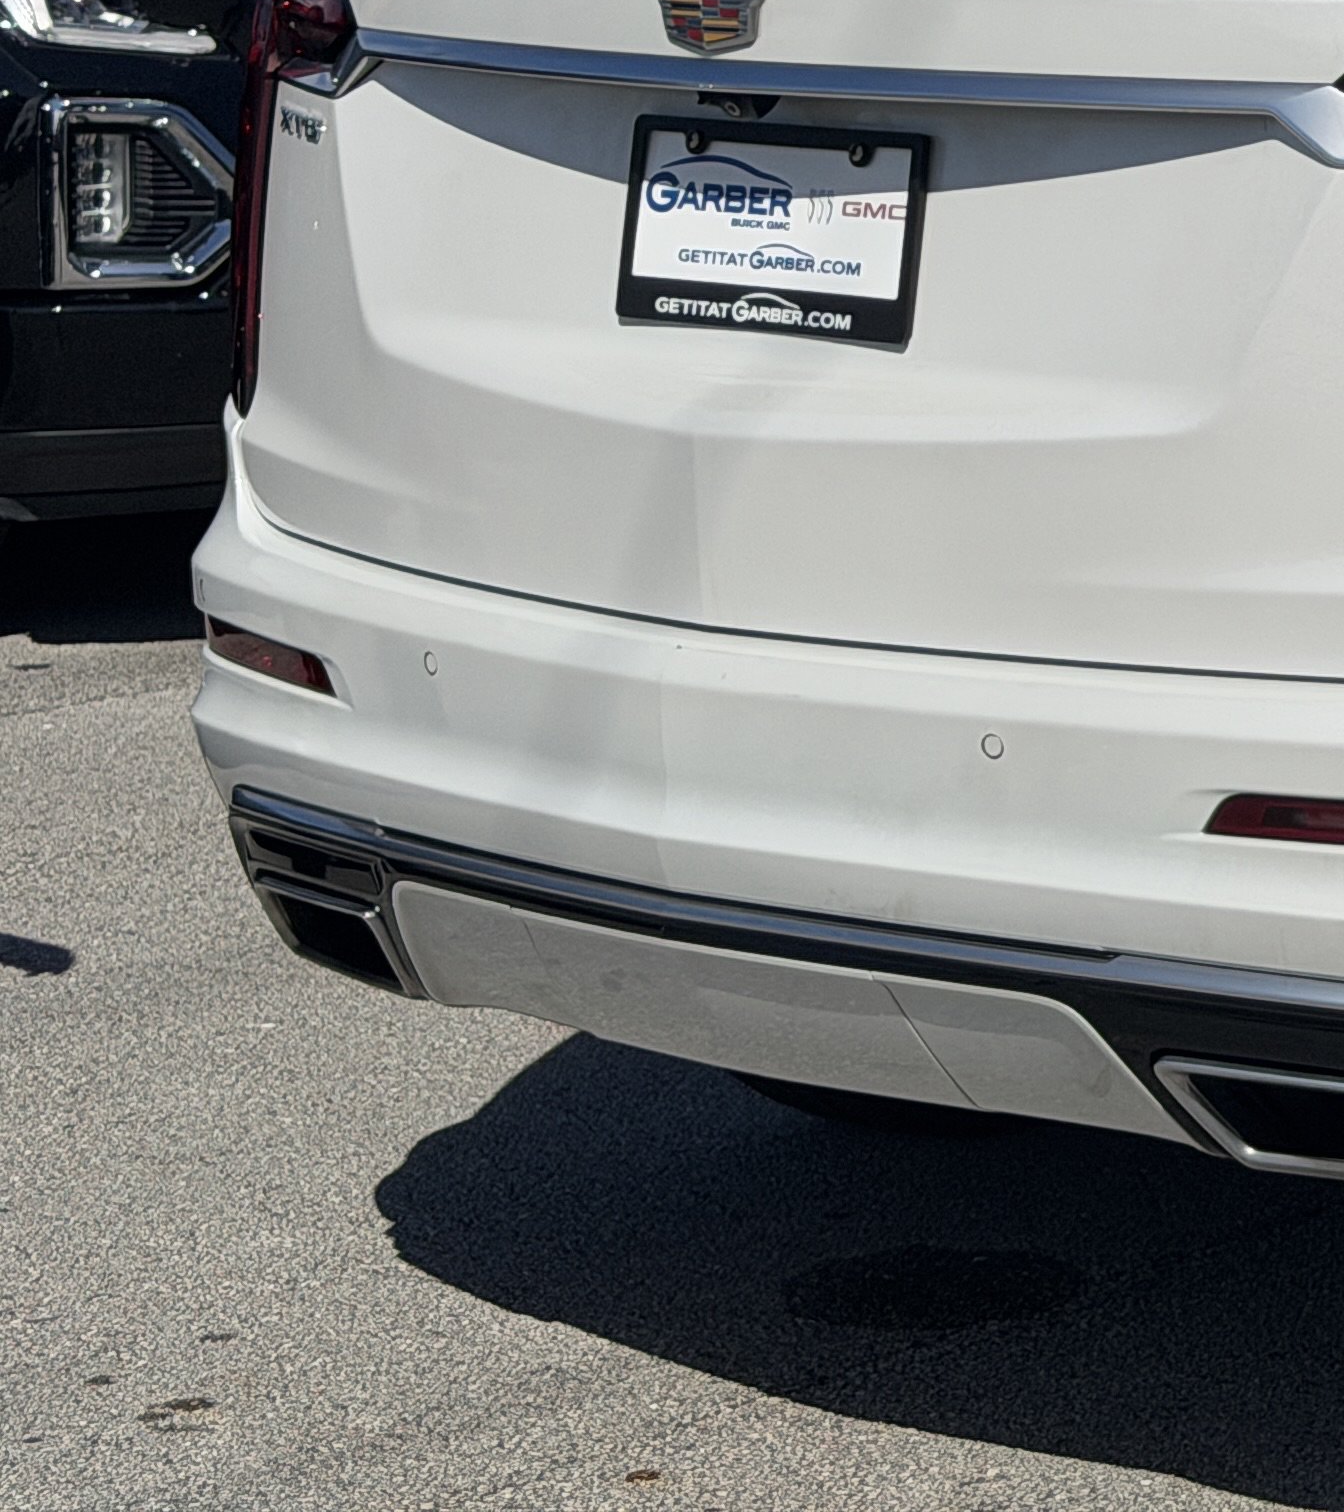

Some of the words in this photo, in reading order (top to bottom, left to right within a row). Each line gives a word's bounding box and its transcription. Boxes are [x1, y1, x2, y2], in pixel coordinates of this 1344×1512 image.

[645, 171, 793, 218] GARBER
[841, 200, 907, 221] GMC
[730, 217, 764, 229] BUICK
[766, 220, 790, 232] GMC
